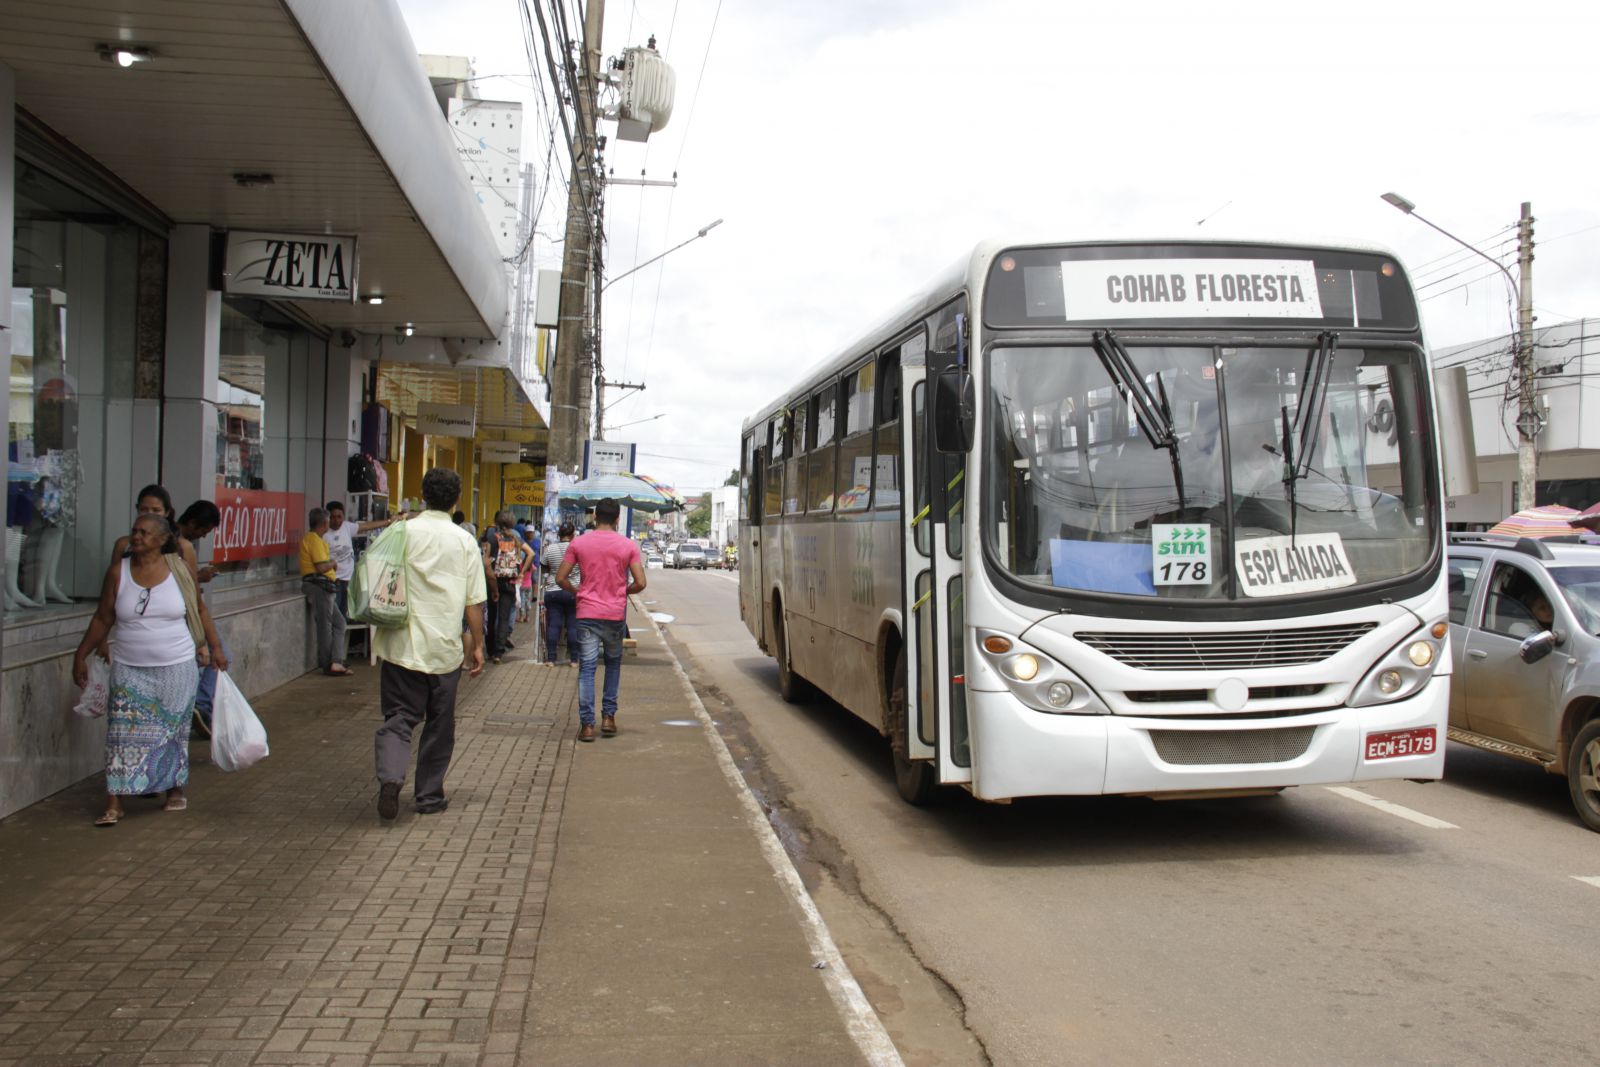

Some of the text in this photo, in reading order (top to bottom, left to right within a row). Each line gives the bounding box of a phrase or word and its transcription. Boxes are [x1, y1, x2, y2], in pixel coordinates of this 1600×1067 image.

[263, 240, 349, 290] ZETA
[1106, 273, 1305, 303] COHAB FLORESTA
[251, 506, 287, 547] TOTAL
[1157, 541, 1206, 555] sim
[1160, 562, 1207, 581] 178
[1240, 544, 1348, 586] ESPLANADA
[1368, 736, 1433, 758] ECM-5179
